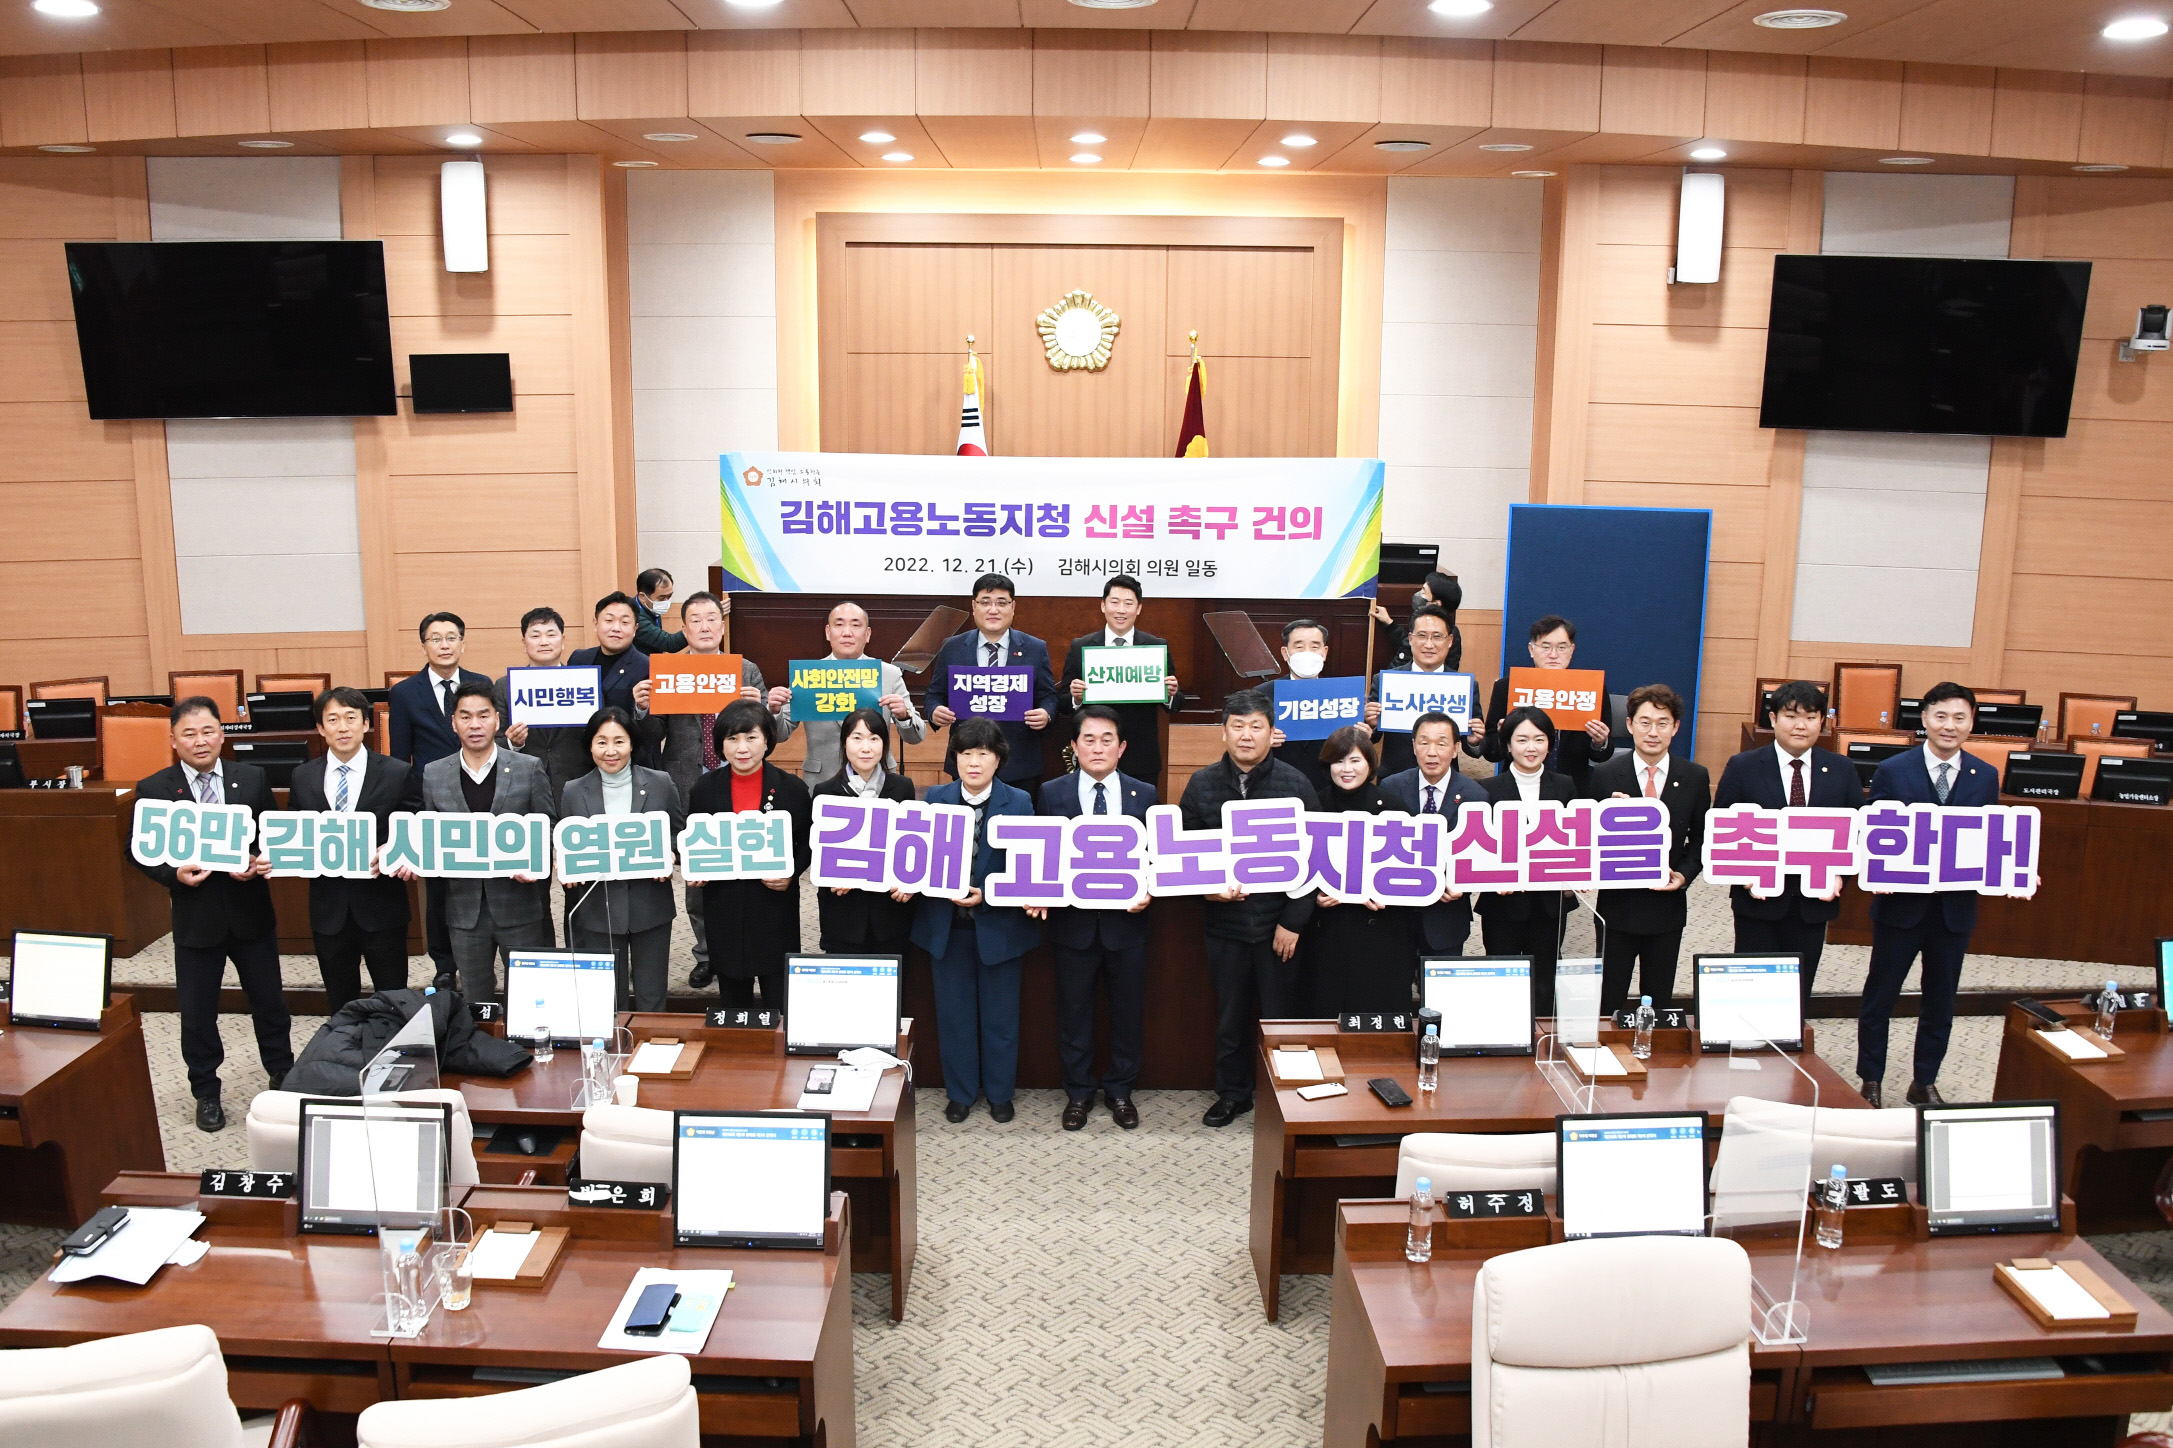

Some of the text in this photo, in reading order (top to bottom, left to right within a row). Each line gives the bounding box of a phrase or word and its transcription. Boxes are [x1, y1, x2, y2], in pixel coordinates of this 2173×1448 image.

[780, 500, 1323, 540] 김해고용노동지청 신설 촉구 건의
[883, 557, 934, 573] 2022.
[942, 558, 968, 573] 12.
[1057, 558, 1141, 577] 김해시의회
[1146, 559, 1179, 577] 의원
[1185, 560, 1218, 578] 일동
[655, 673, 737, 695] 고용안정
[791, 668, 879, 690] 사회안전망
[953, 673, 1029, 694] 지역경제
[1086, 664, 1162, 685] 산재예방
[514, 686, 595, 707] 시민행복
[814, 692, 857, 714] 강화
[968, 694, 1008, 714] 성장
[1384, 692, 1467, 714] 노사상생
[1512, 687, 1597, 713] 고용안정
[1278, 697, 1360, 721] 기업성장
[28, 779, 67, 790] 부시장
[138, 806, 248, 865] 56만
[265, 817, 369, 872] 김해
[385, 818, 543, 873] 시민의
[560, 818, 666, 876] 염원
[684, 818, 787, 874] 실현
[818, 803, 966, 890] 김해
[993, 823, 1141, 900] 고용
[1451, 805, 1664, 885] 신설을
[1710, 811, 1854, 890] 촉구
[1865, 808, 2032, 888] 한다!
[1623, 1012, 1680, 1029] 김상
[209, 1172, 284, 1195] 김창수
